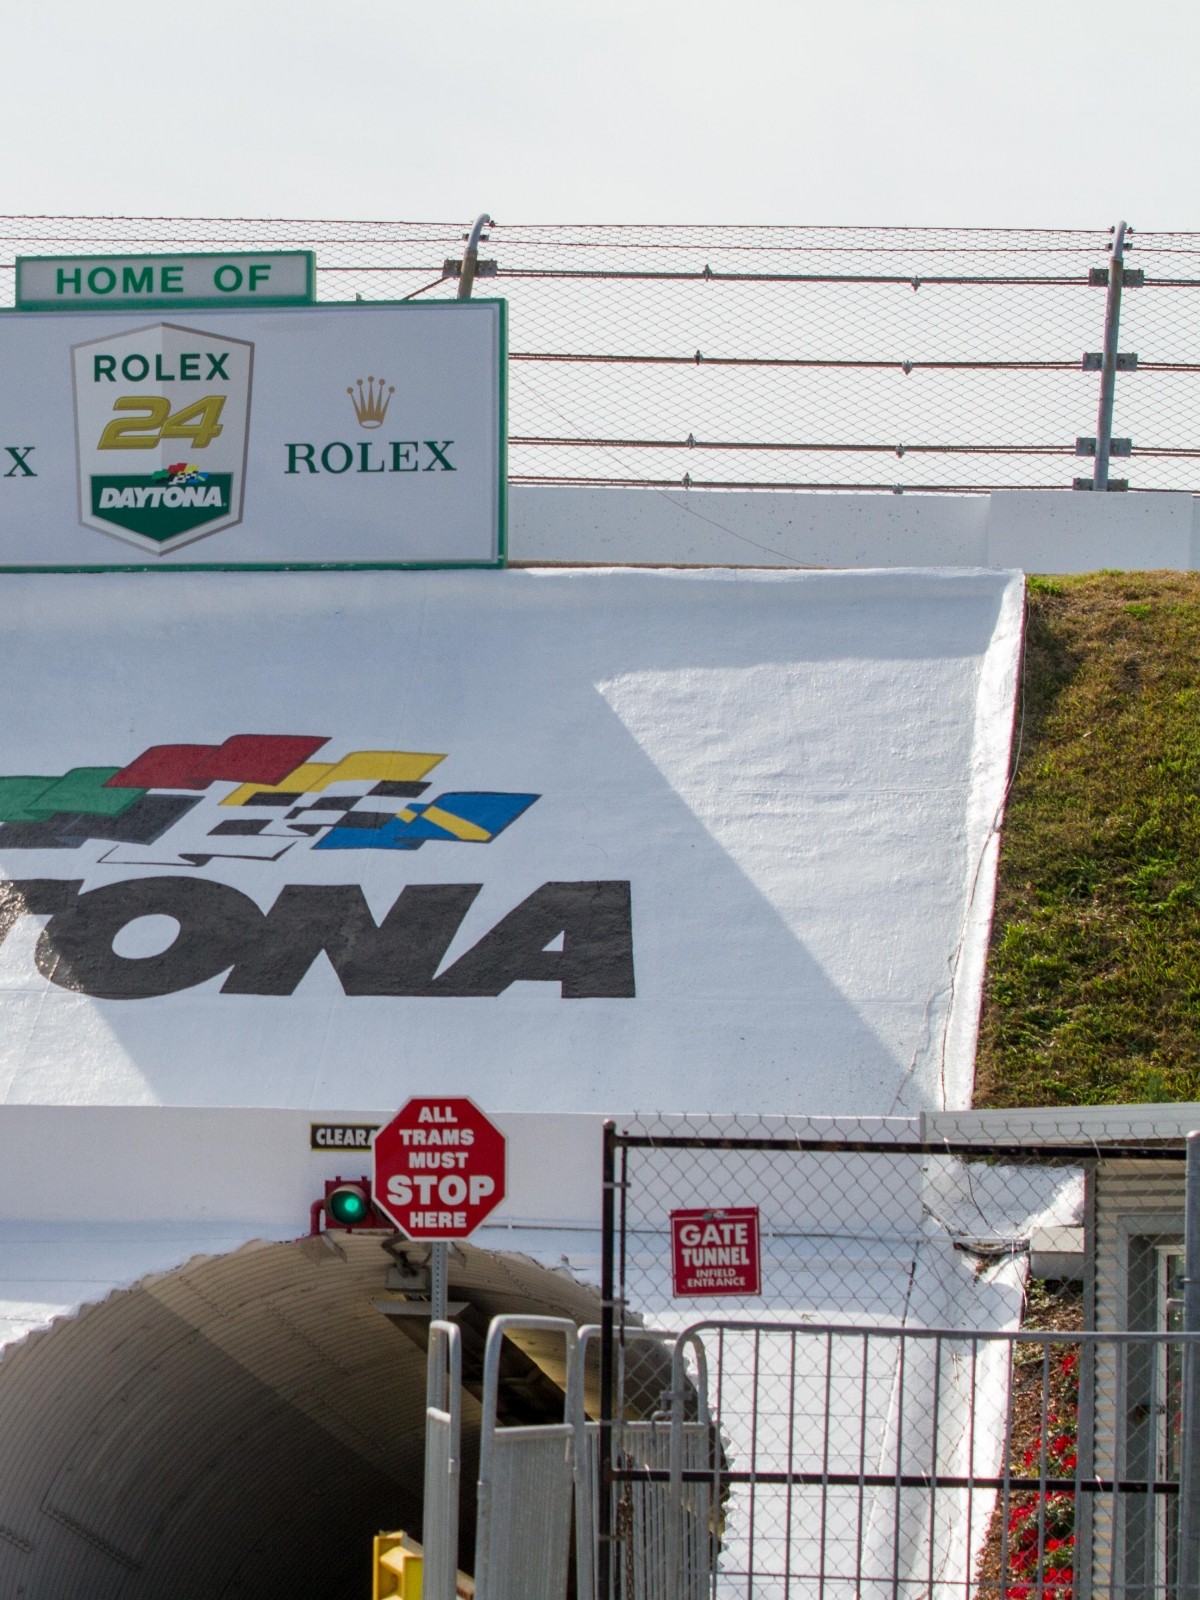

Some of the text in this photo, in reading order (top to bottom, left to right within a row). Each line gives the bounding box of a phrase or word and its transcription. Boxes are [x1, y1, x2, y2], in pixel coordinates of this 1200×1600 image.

[57, 264, 272, 294] HOME OF
[94, 352, 230, 382] ROLEX
[98, 395, 227, 450] 24
[285, 440, 457, 474] ROLEX
[99, 486, 223, 509] DAYTONA
[418, 1106, 458, 1123] ALL
[315, 1128, 378, 1146] CLEARA
[399, 1129, 474, 1146] TRAMS
[408, 1152, 469, 1169] MUST
[387, 1175, 495, 1206] STOP
[410, 1211, 467, 1228] HERE
[679, 1223, 749, 1247] GATE
[681, 1247, 750, 1267] TUNNEL
[687, 1276, 746, 1287] ENTRANCE
[696, 1268, 736, 1278] INFIELD
